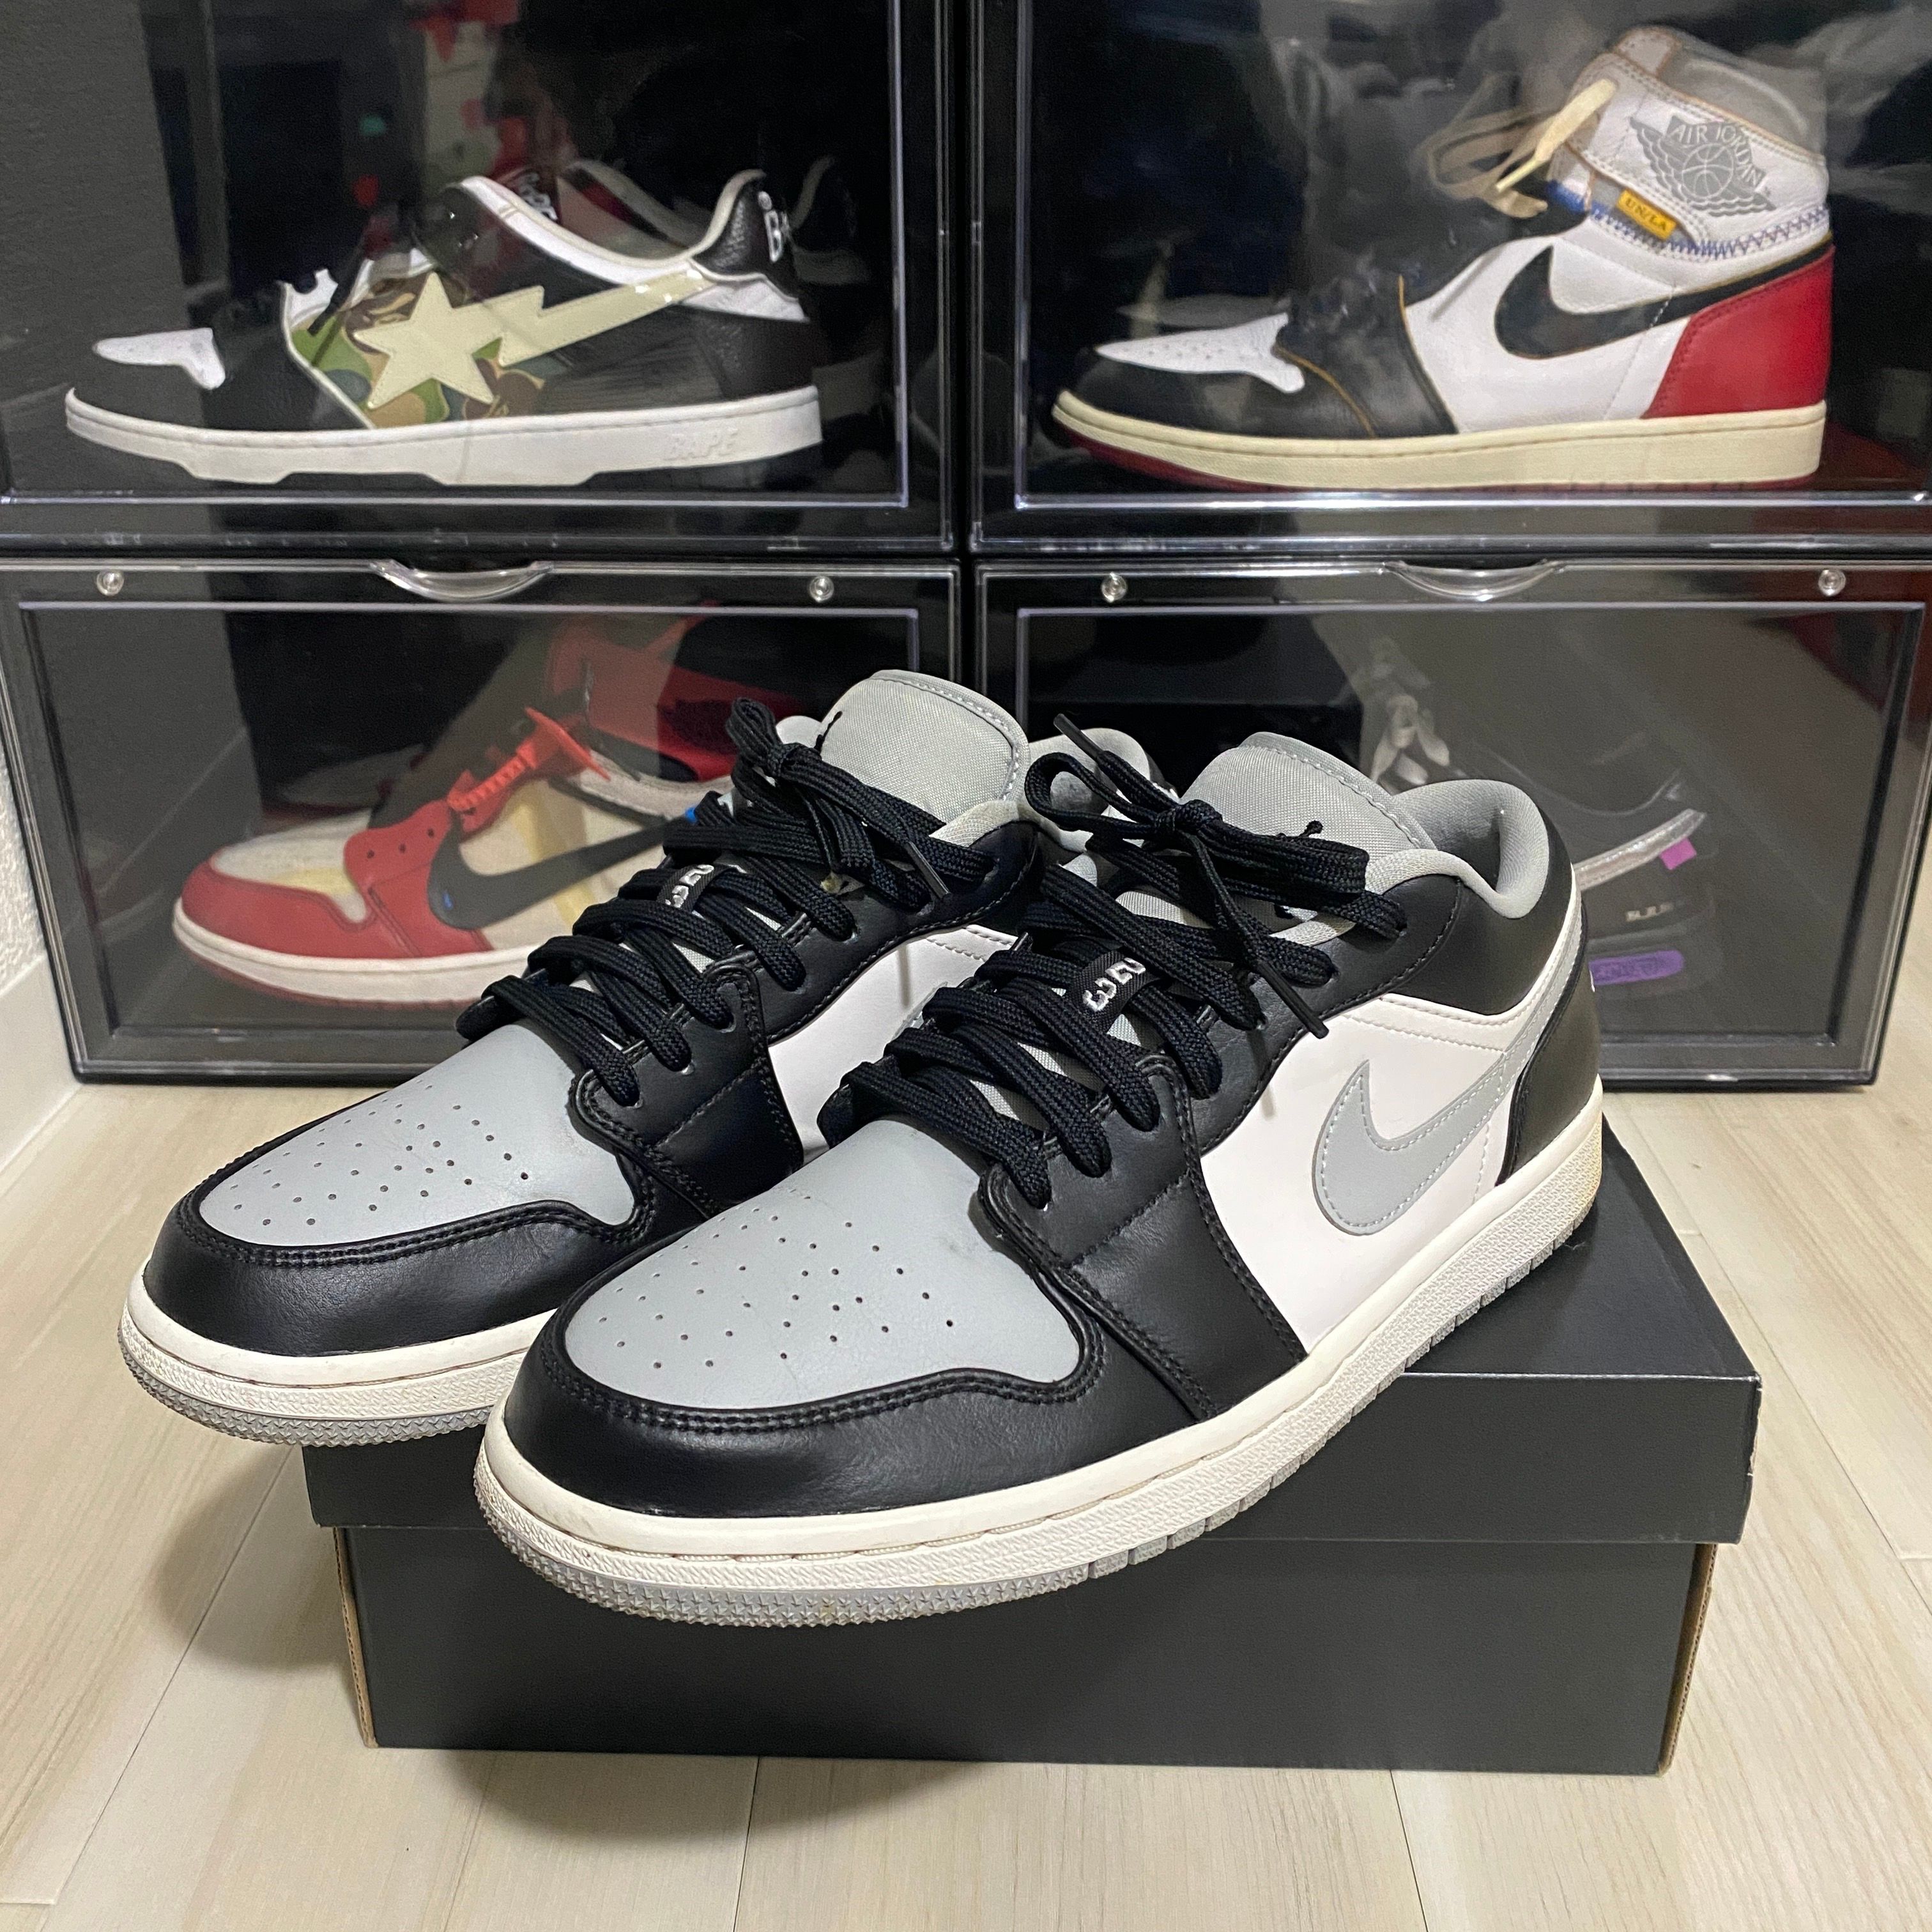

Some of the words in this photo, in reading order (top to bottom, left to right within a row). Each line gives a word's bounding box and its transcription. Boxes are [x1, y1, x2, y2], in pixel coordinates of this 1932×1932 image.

[1669, 123, 1708, 144] AIR
[1715, 123, 1763, 187] JORDAN
[1624, 197, 1667, 231] UN/LA
[663, 427, 739, 463] BAPE
[1081, 956, 1147, 1013] 23
